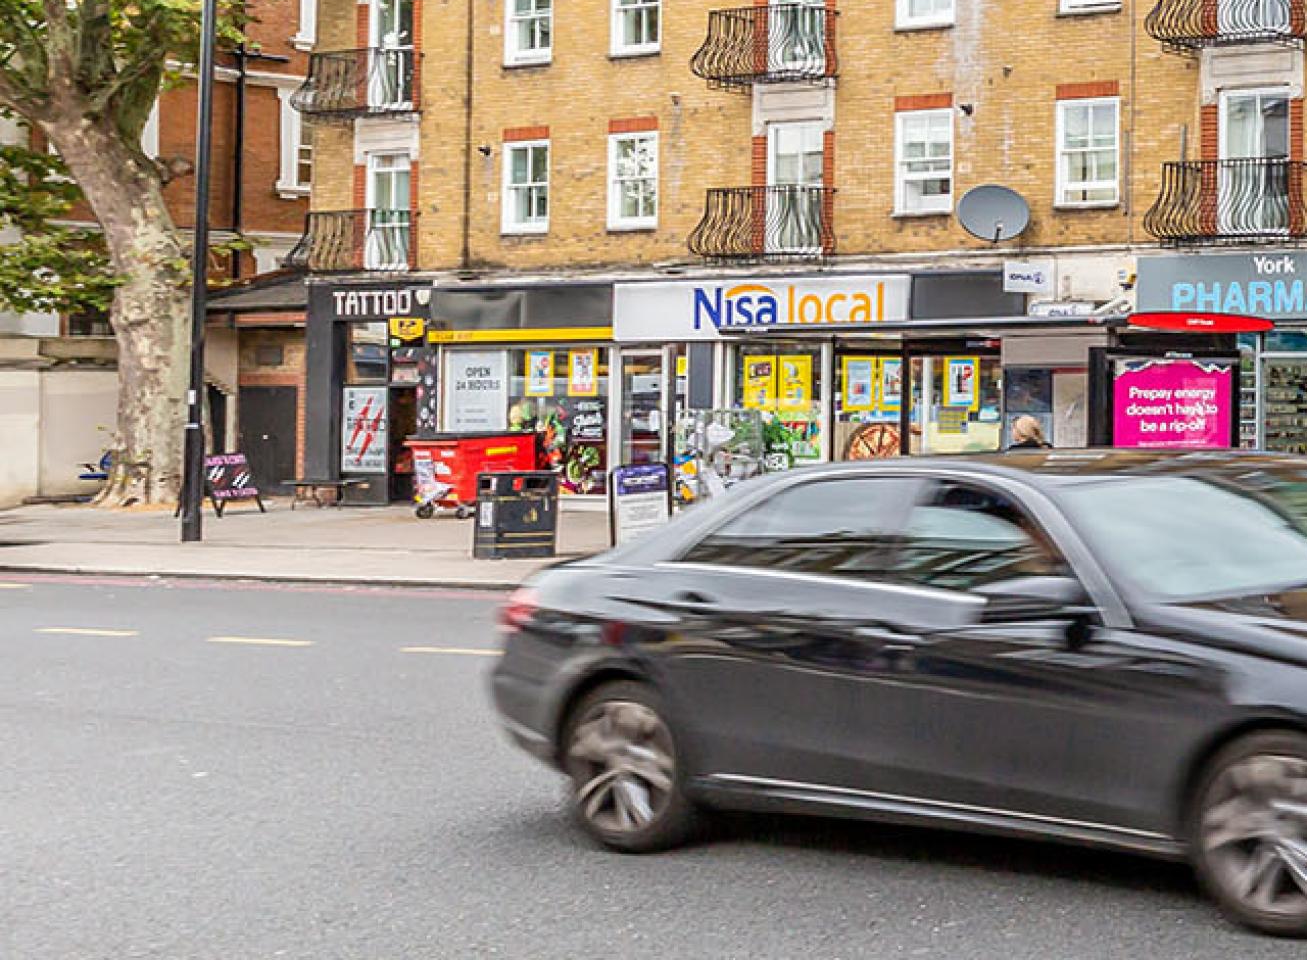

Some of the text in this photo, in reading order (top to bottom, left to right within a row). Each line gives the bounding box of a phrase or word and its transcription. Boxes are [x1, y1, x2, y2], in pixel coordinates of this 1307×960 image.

[1253, 256, 1296, 275] York
[333, 292, 411, 316] TATTOO
[694, 281, 886, 329] Nisa local
[465, 366, 491, 378] OPEN
[1128, 386, 1216, 401] Prepay energy
[1126, 402, 1173, 416] doesn't
[1141, 418, 1207, 434] be a rip-off
